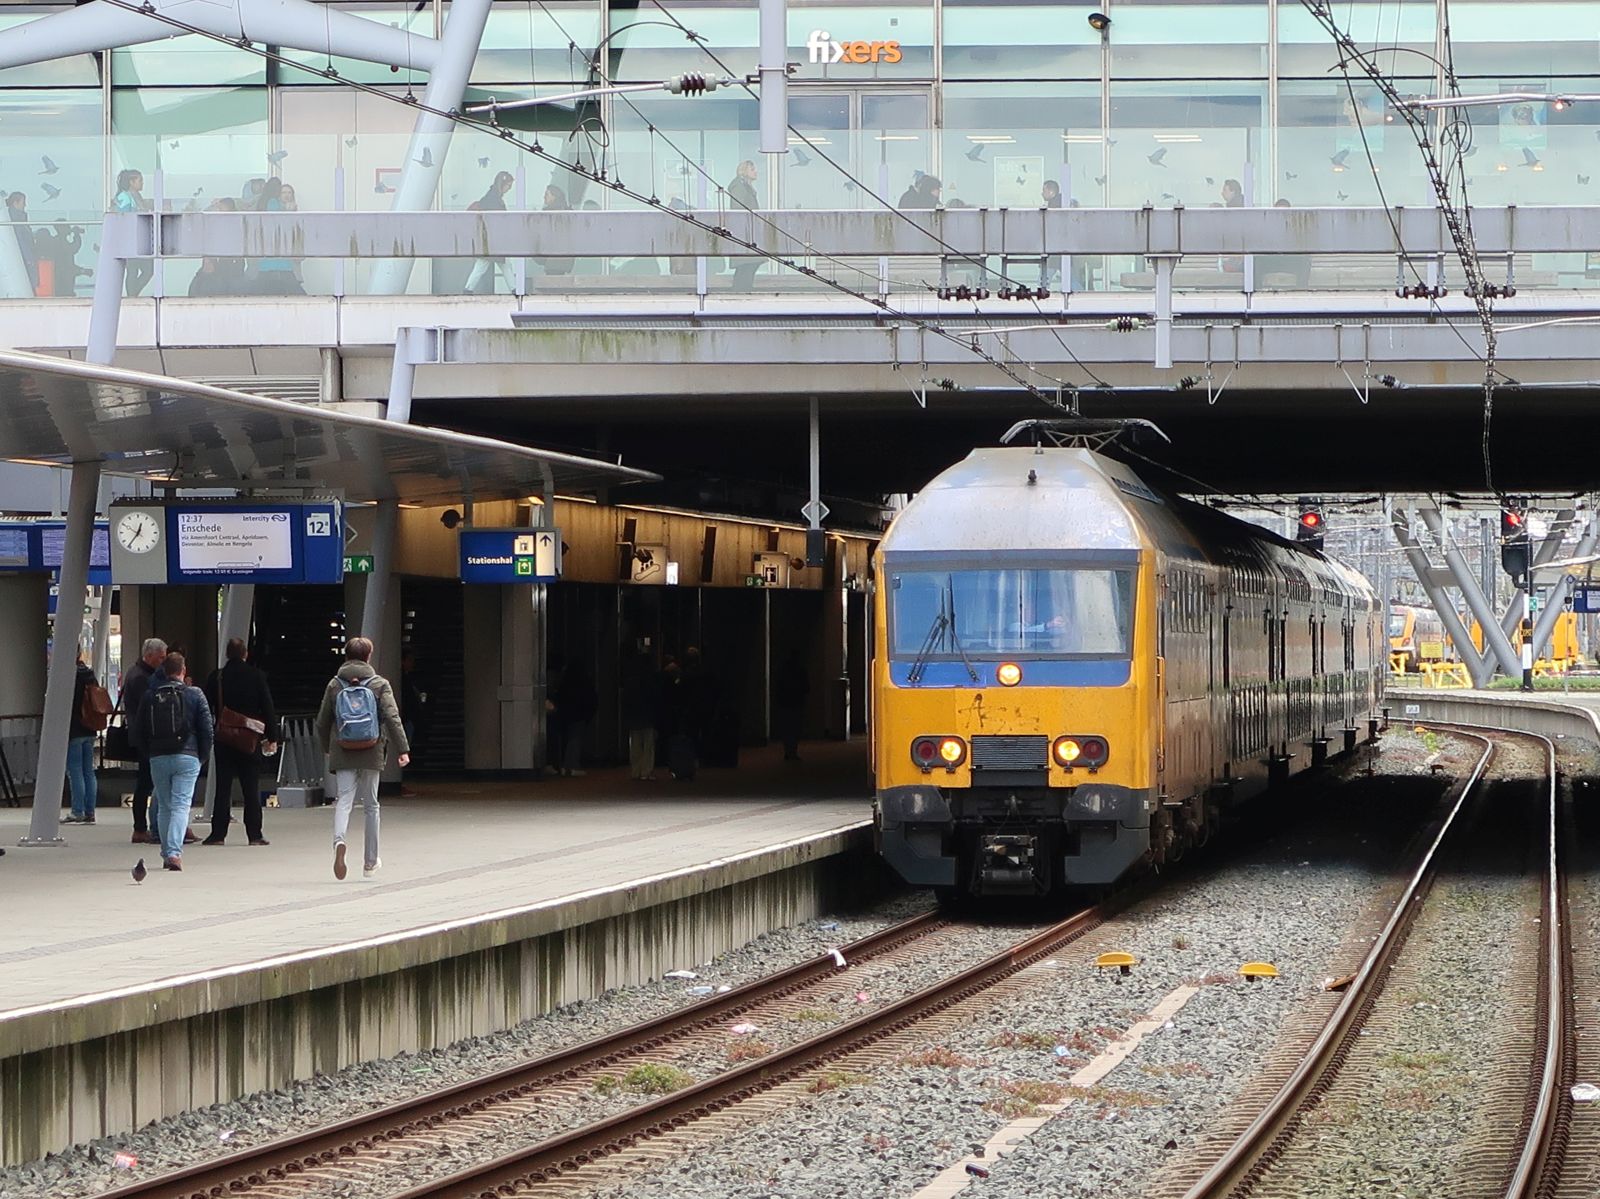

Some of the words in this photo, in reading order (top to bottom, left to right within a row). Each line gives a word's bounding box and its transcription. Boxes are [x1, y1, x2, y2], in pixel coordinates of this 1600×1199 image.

[807, 29, 902, 63] fixers
[181, 515, 203, 523] 12:37
[242, 515, 269, 523] Intercity
[181, 524, 222, 533] Enschede
[467, 556, 513, 565] Stationshal
